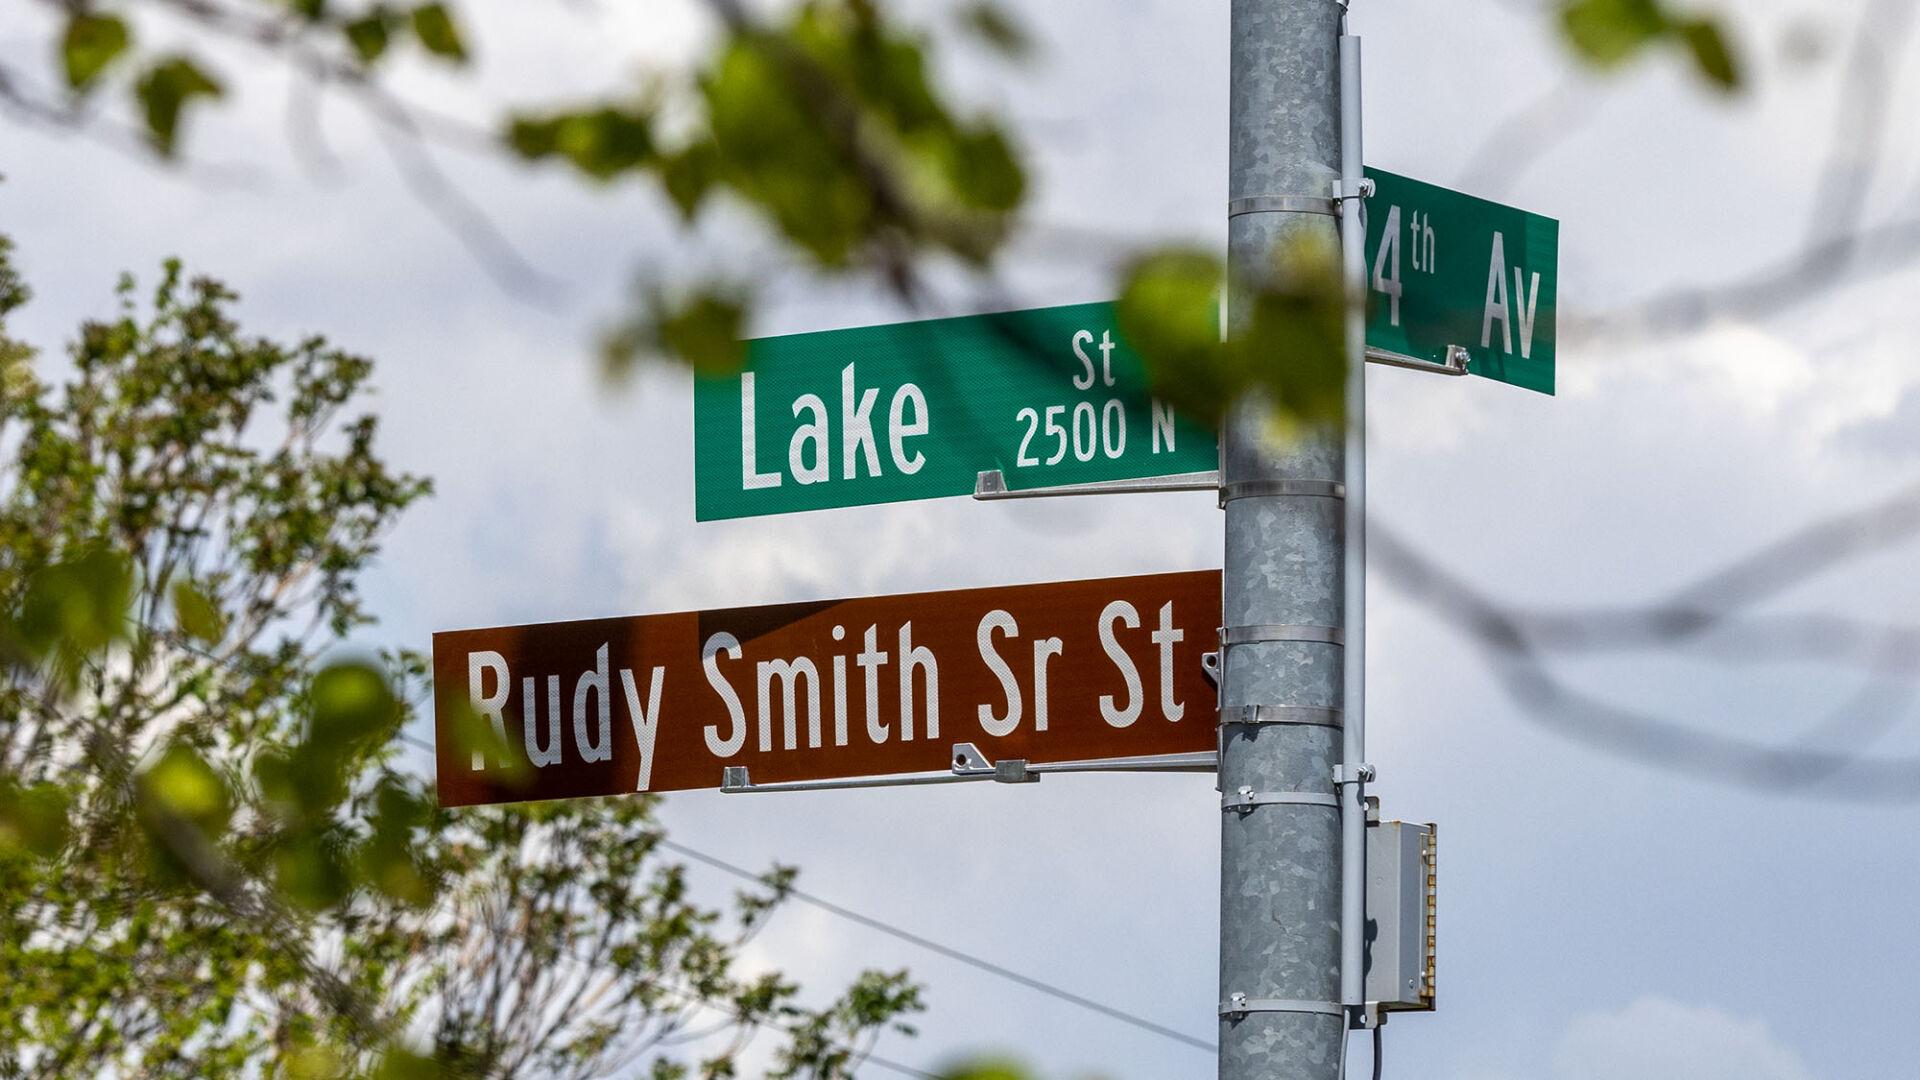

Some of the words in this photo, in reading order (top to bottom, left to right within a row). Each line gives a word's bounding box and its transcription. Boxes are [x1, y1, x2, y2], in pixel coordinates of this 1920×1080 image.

[1361, 202, 1436, 327] 4th
[1480, 230, 1541, 360] Av
[1071, 329, 1116, 390] St
[741, 361, 930, 491] Lake
[1016, 398, 1127, 468] 2500
[1151, 394, 1176, 455] N
[467, 641, 666, 792] Rudy
[702, 620, 940, 758] Smith
[976, 609, 1064, 738] Sr
[1097, 599, 1186, 729] St
